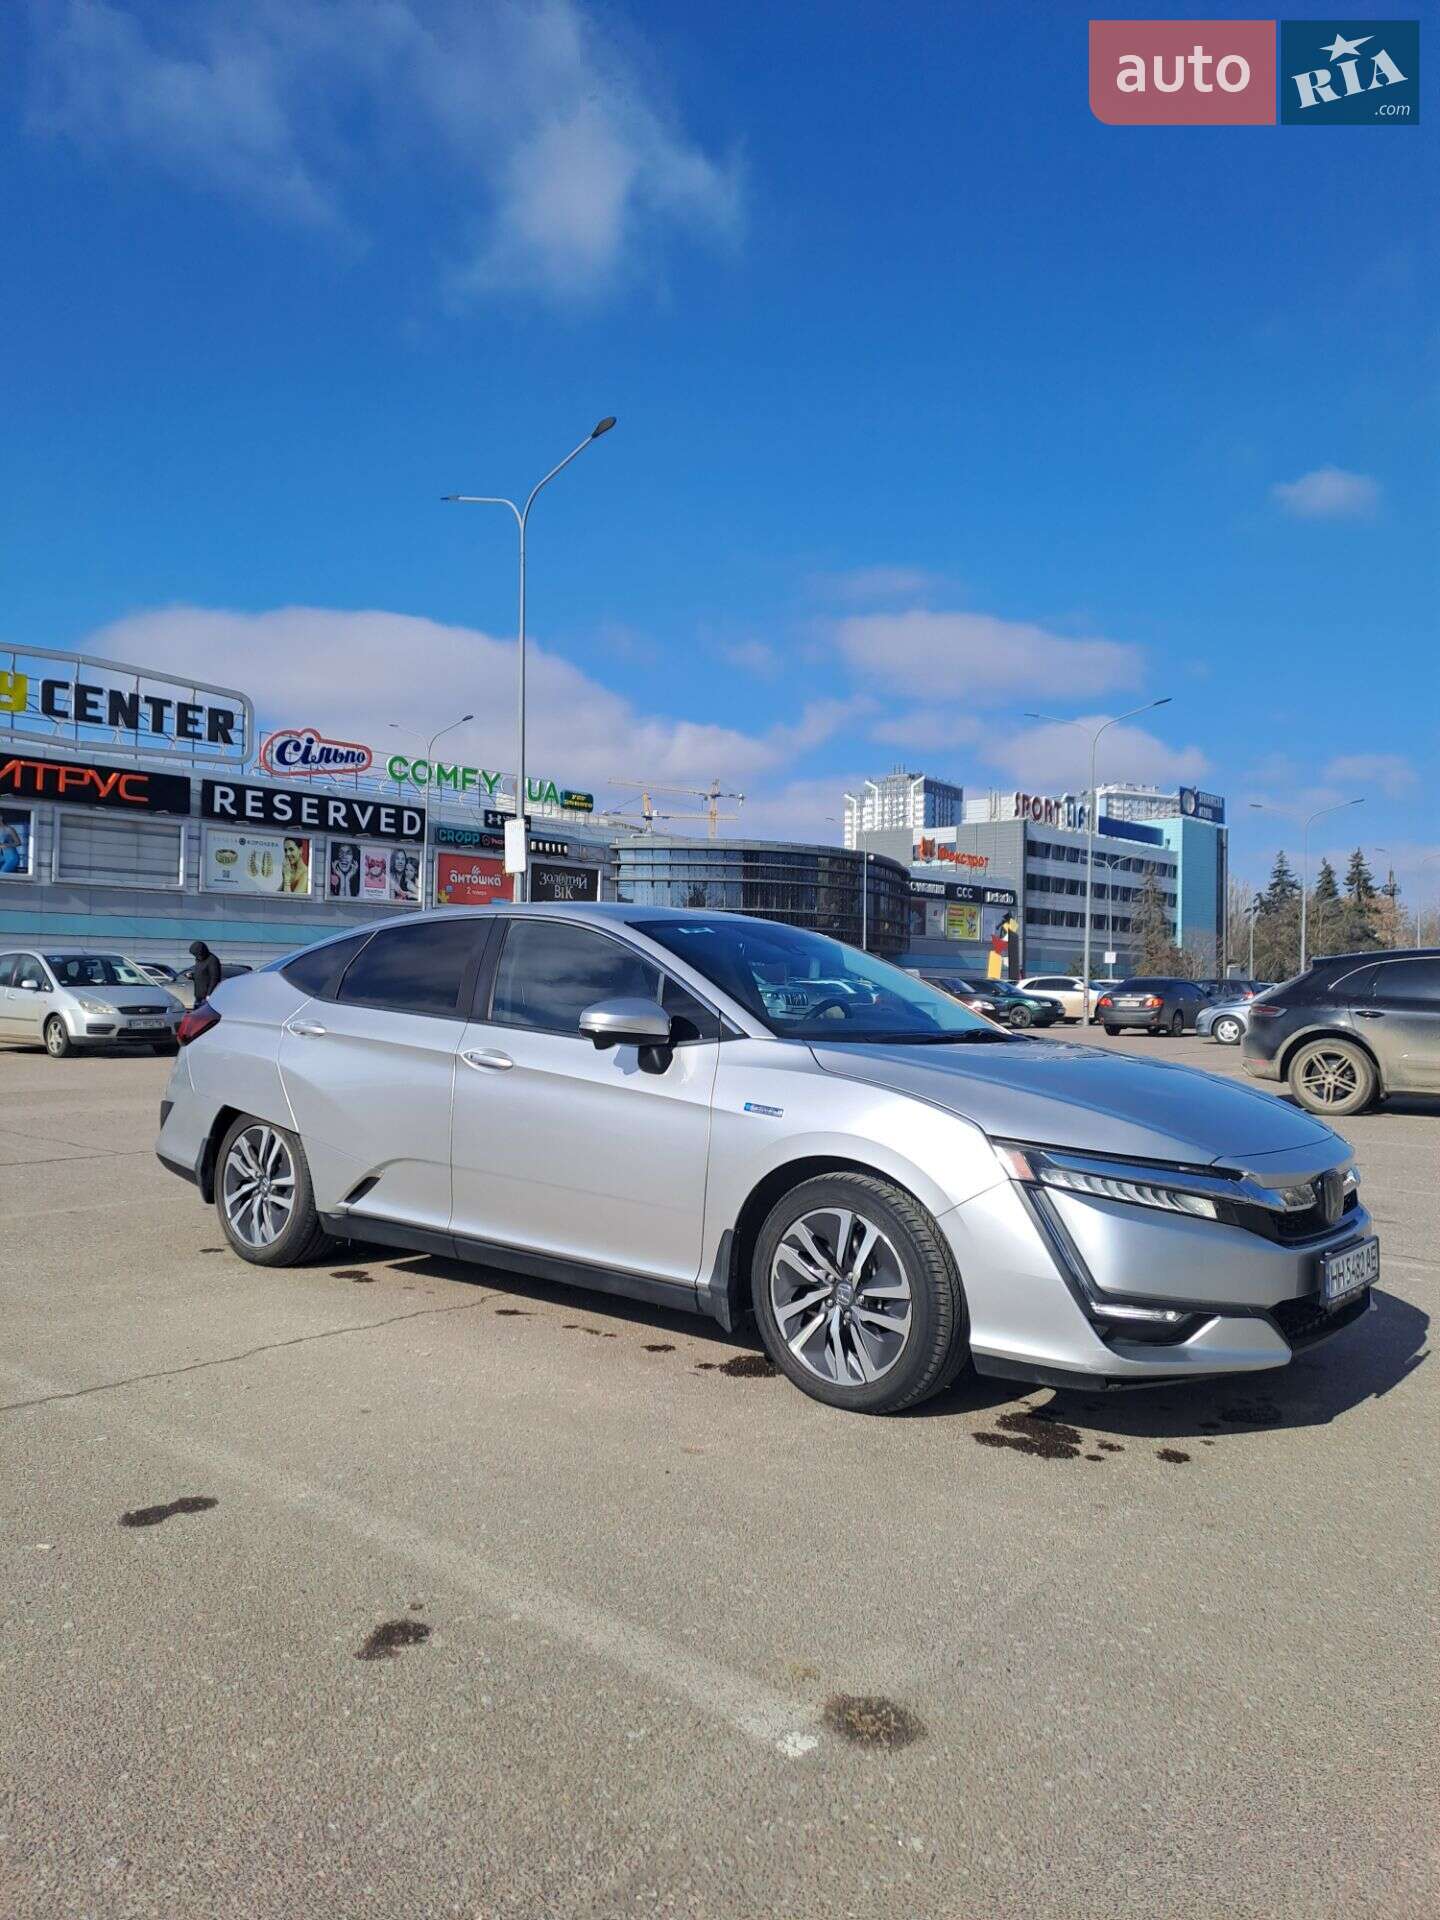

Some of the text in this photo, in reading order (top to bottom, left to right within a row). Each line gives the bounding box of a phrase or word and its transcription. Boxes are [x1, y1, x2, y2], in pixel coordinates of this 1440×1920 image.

[39, 679, 235, 745] CENTER
[275, 737, 366, 766] Сільпо
[386, 755, 501, 795] COMFY
[213, 786, 421, 835] RESERVED
[1013, 791, 1062, 826] SPORT
[439, 828, 480, 846] CROPP
